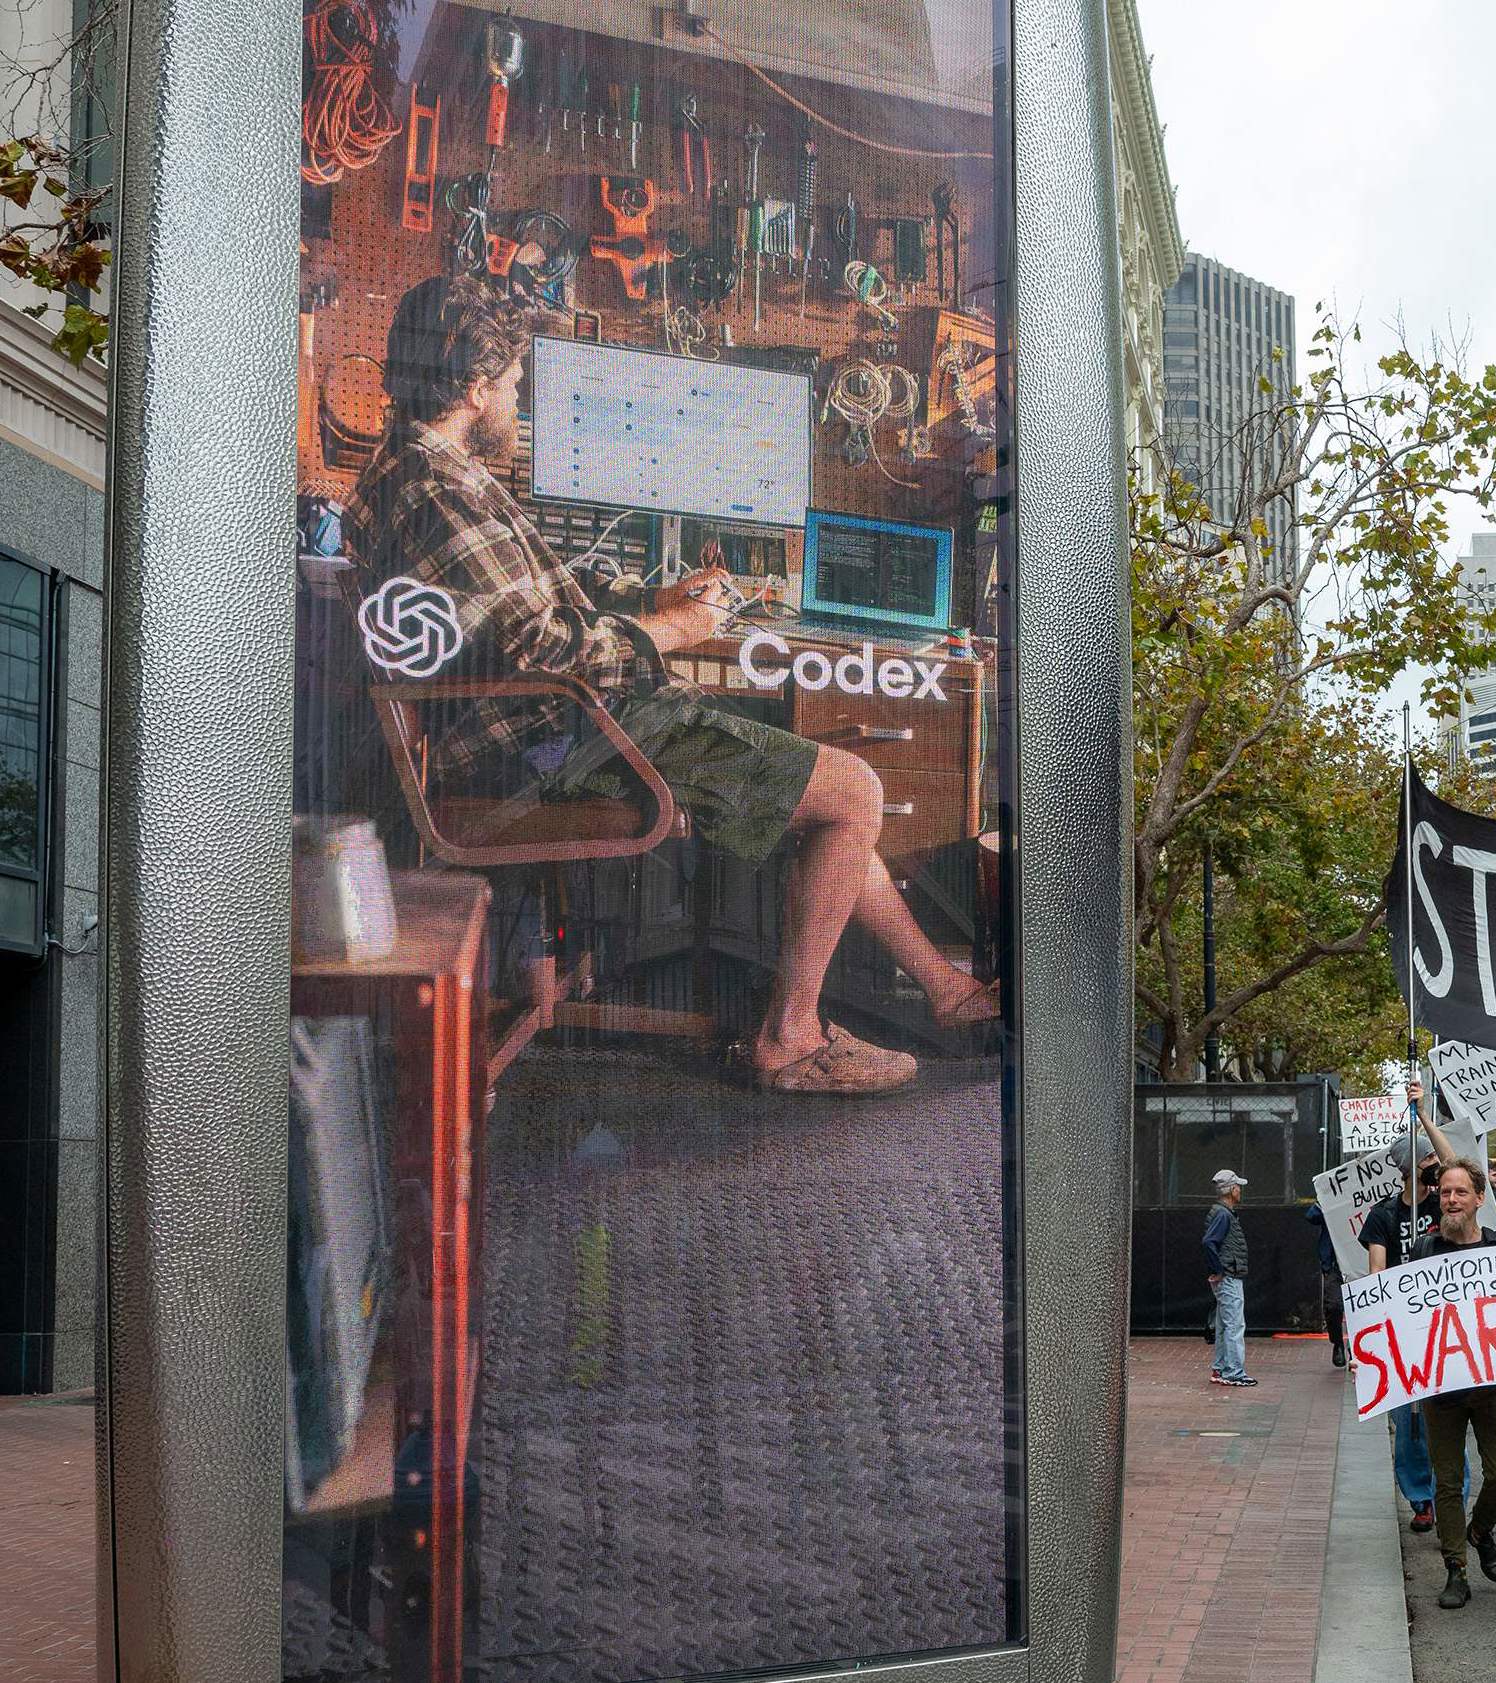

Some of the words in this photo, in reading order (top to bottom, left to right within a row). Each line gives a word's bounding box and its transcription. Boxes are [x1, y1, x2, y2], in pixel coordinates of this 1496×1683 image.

[739, 632, 948, 701] Codex
[1340, 1097, 1394, 1112] CHATGPT
[1346, 1135, 1381, 1149] THIS
[1351, 1125, 1362, 1135] A
[1329, 1167, 1349, 1197] IF
[1356, 1159, 1384, 1187] NO
[1352, 1177, 1404, 1208] BUILDS
[1345, 1274, 1393, 1313] task
